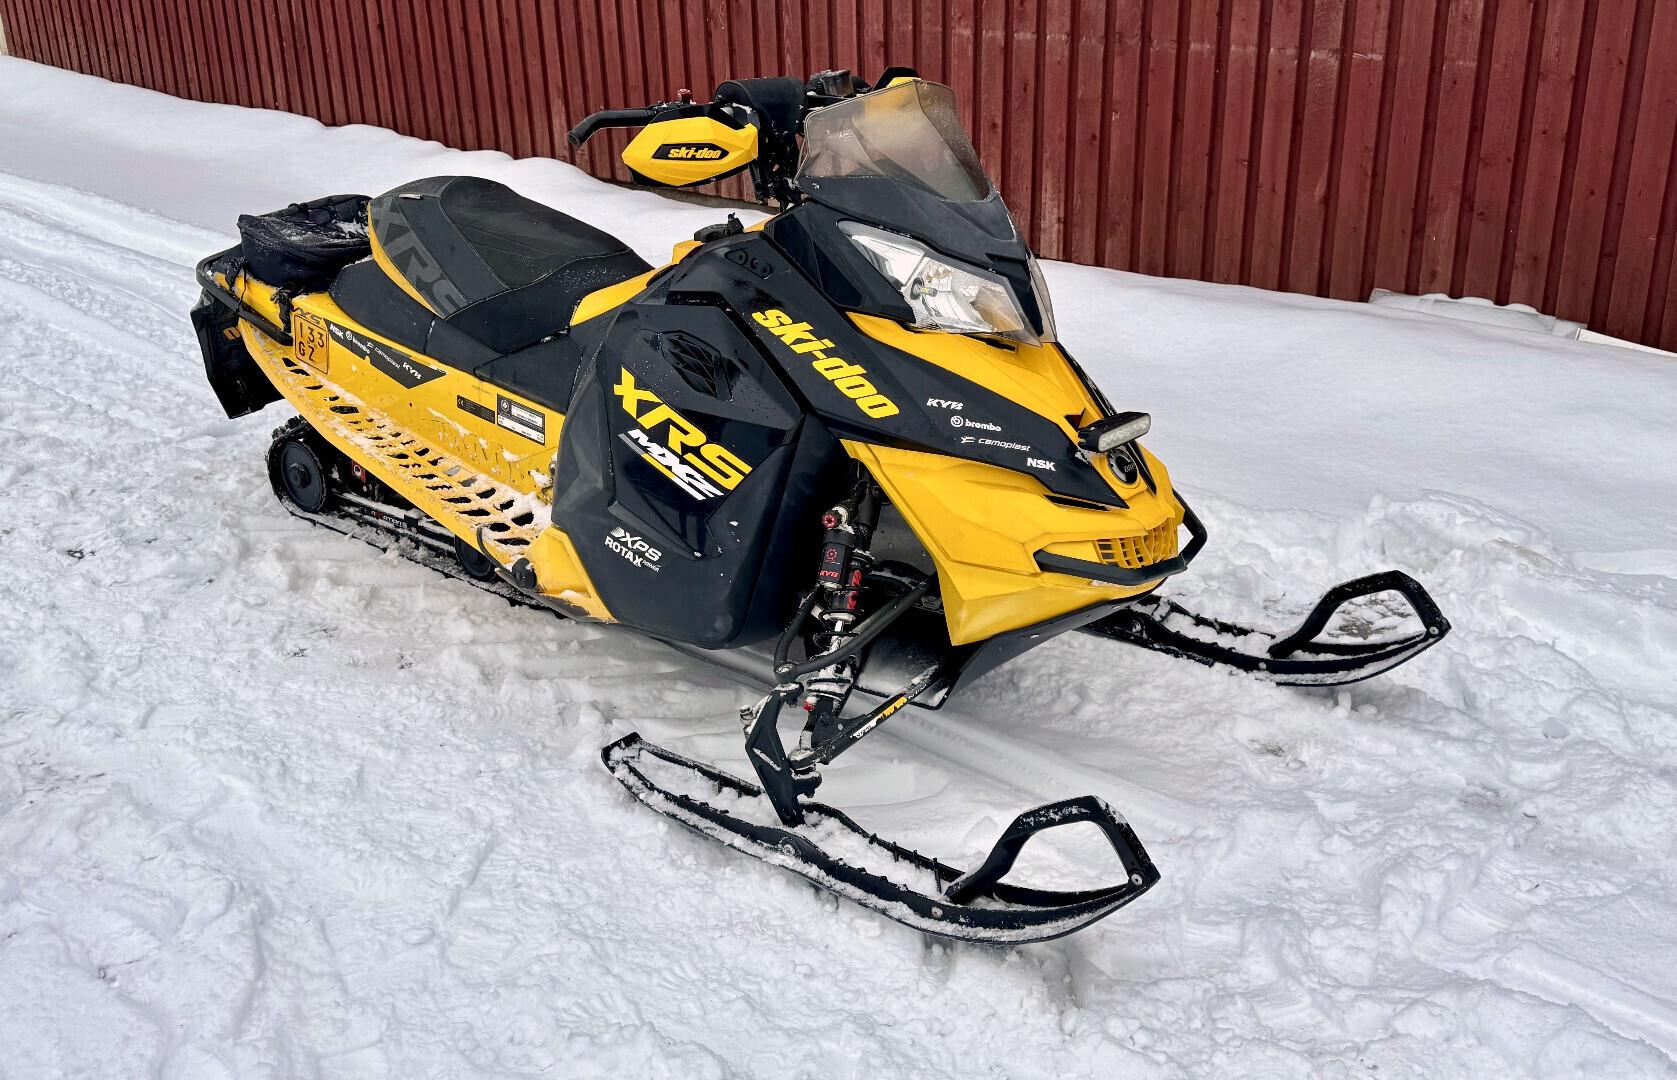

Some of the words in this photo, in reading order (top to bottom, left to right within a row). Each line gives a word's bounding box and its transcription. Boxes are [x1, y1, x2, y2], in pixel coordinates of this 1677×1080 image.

[667, 147, 722, 159] ski-doo
[752, 309, 900, 419] ski-doo
[926, 398, 964, 410] KYB
[613, 366, 753, 491] XRS
[978, 438, 1031, 452] camoplast
[1026, 457, 1056, 472] NSK
[604, 535, 643, 568] ROTAX
[619, 531, 662, 562] XPS
